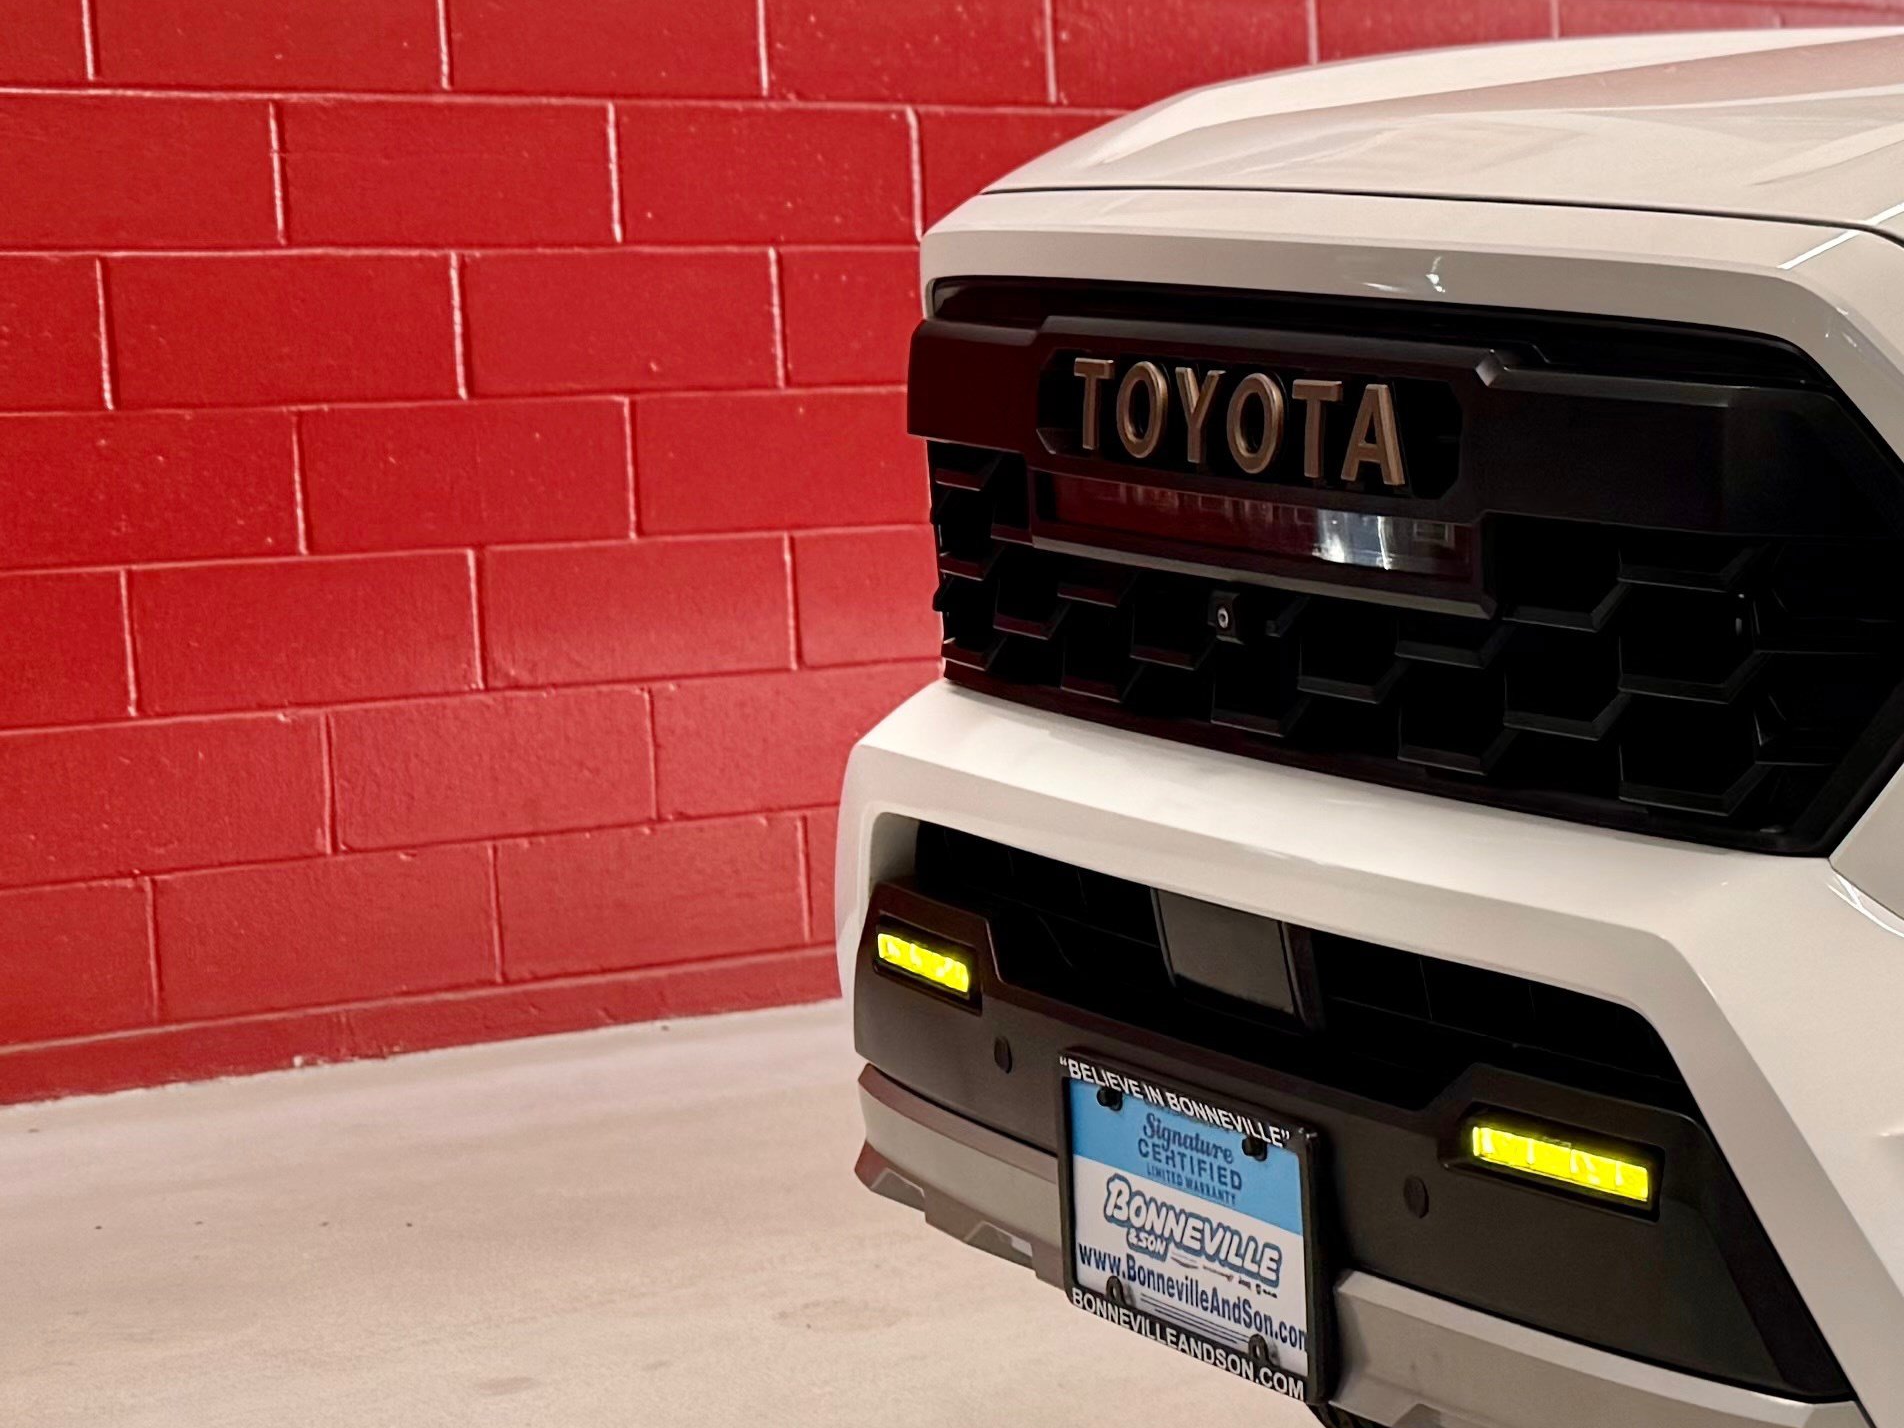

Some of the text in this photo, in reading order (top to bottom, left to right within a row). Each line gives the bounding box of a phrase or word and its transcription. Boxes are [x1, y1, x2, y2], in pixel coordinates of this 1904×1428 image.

[1073, 356, 1406, 486] TOYOTA
[1145, 1084, 1165, 1107] IN
[1137, 1138, 1242, 1191] CERTIFIED
[1143, 1112, 1235, 1165] Signature
[1105, 1175, 1281, 1283] BONNEVILLE
[1071, 1286, 1305, 1401] BONNEVILLEANDSON.COM
